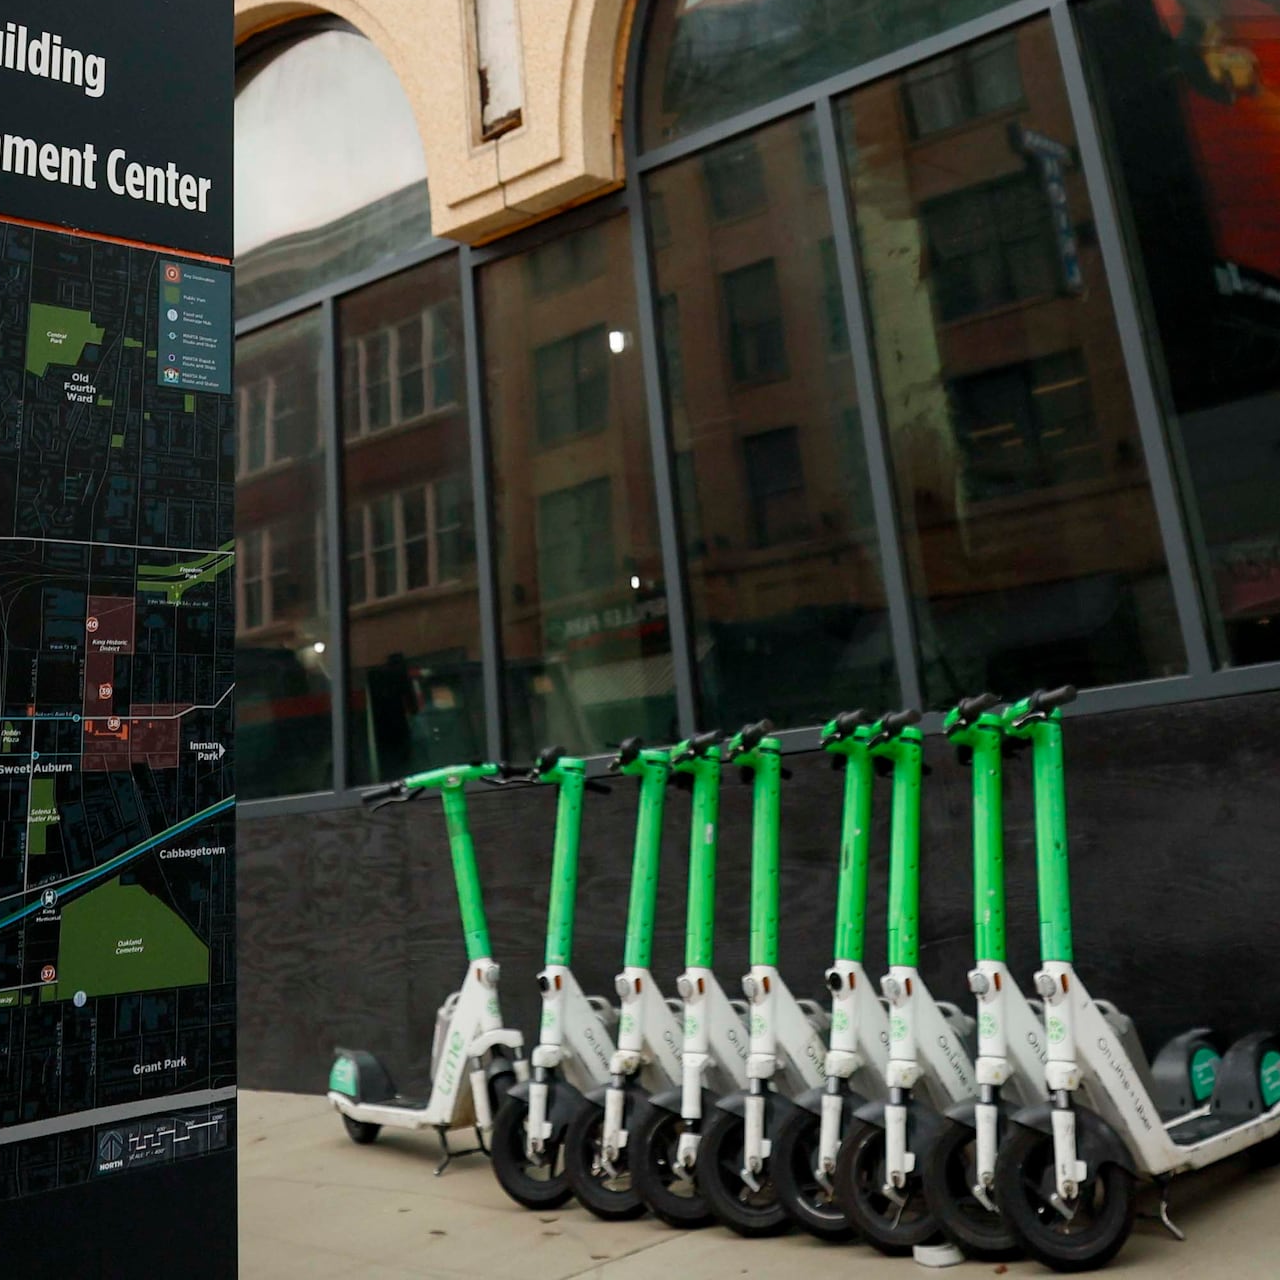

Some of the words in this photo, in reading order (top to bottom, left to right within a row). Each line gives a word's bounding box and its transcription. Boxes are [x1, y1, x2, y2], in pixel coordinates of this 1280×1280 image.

[106, 148, 212, 214] Center
[71, 372, 90, 384] Old
[63, 381, 97, 395] Fourth
[66, 391, 95, 404] Ward
[86, 620, 98, 629] 40
[91, 638, 106, 647] King
[106, 638, 129, 647] Historic
[99, 645, 120, 653] District
[108, 718, 120, 728] 38
[189, 740, 219, 751] Inman
[197, 751, 219, 761] Park
[32, 762, 73, 774] Auburn
[159, 844, 227, 860] Cabbagetown
[117, 937, 143, 948] Oakland
[115, 944, 145, 956] Cemetery
[132, 1061, 162, 1076] Grant
[163, 1056, 188, 1070] Park
[99, 1159, 124, 1172] NORTH
